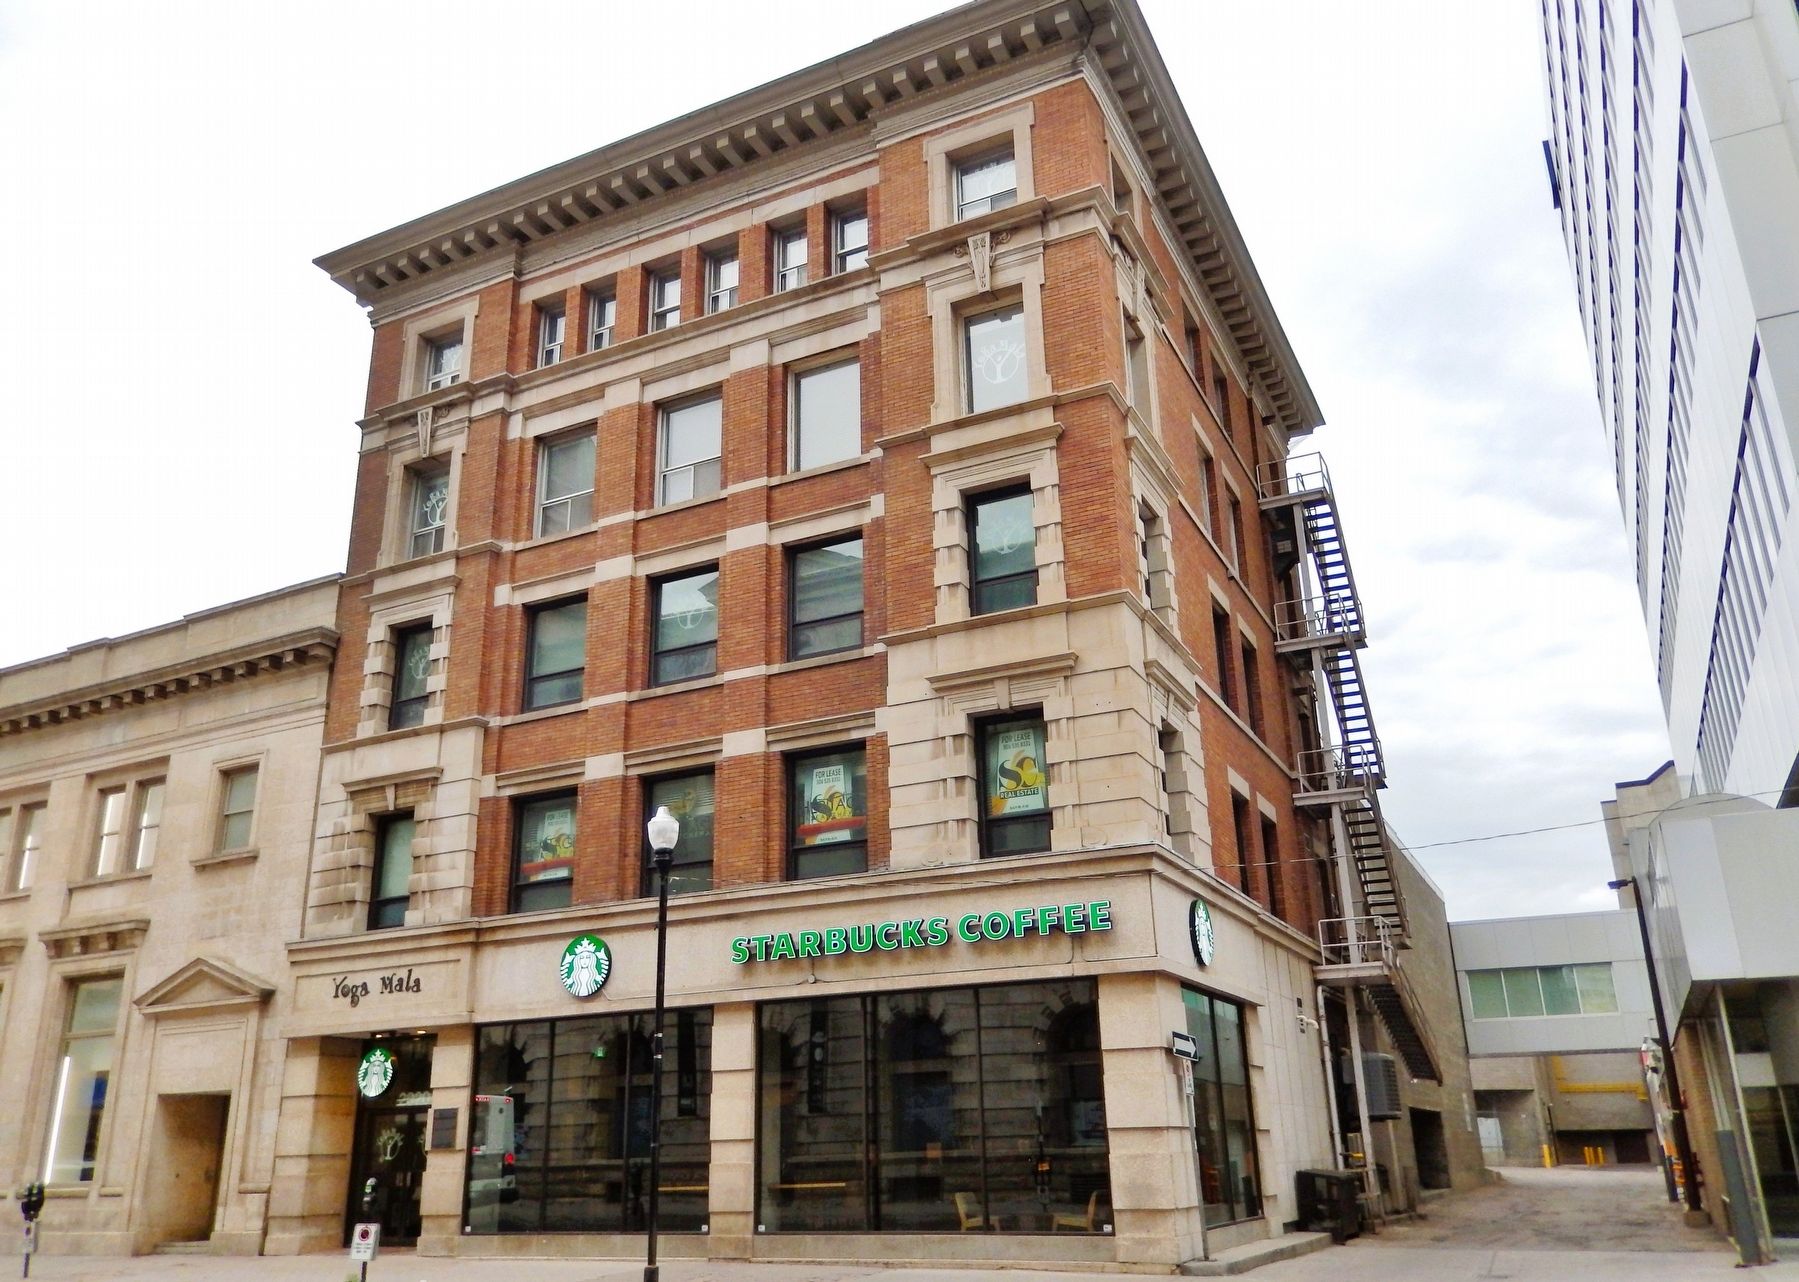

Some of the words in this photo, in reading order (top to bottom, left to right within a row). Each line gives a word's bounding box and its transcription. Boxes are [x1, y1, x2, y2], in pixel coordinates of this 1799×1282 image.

[815, 770, 826, 779] FOR
[826, 768, 841, 777] LEASE
[1000, 791, 1016, 799] REAL
[1017, 787, 1039, 797] ESTATE
[731, 917, 949, 965] STARBUCKS
[957, 900, 1112, 943] COFFEE
[333, 976, 370, 1008] Yoga
[380, 968, 421, 994] Mala
